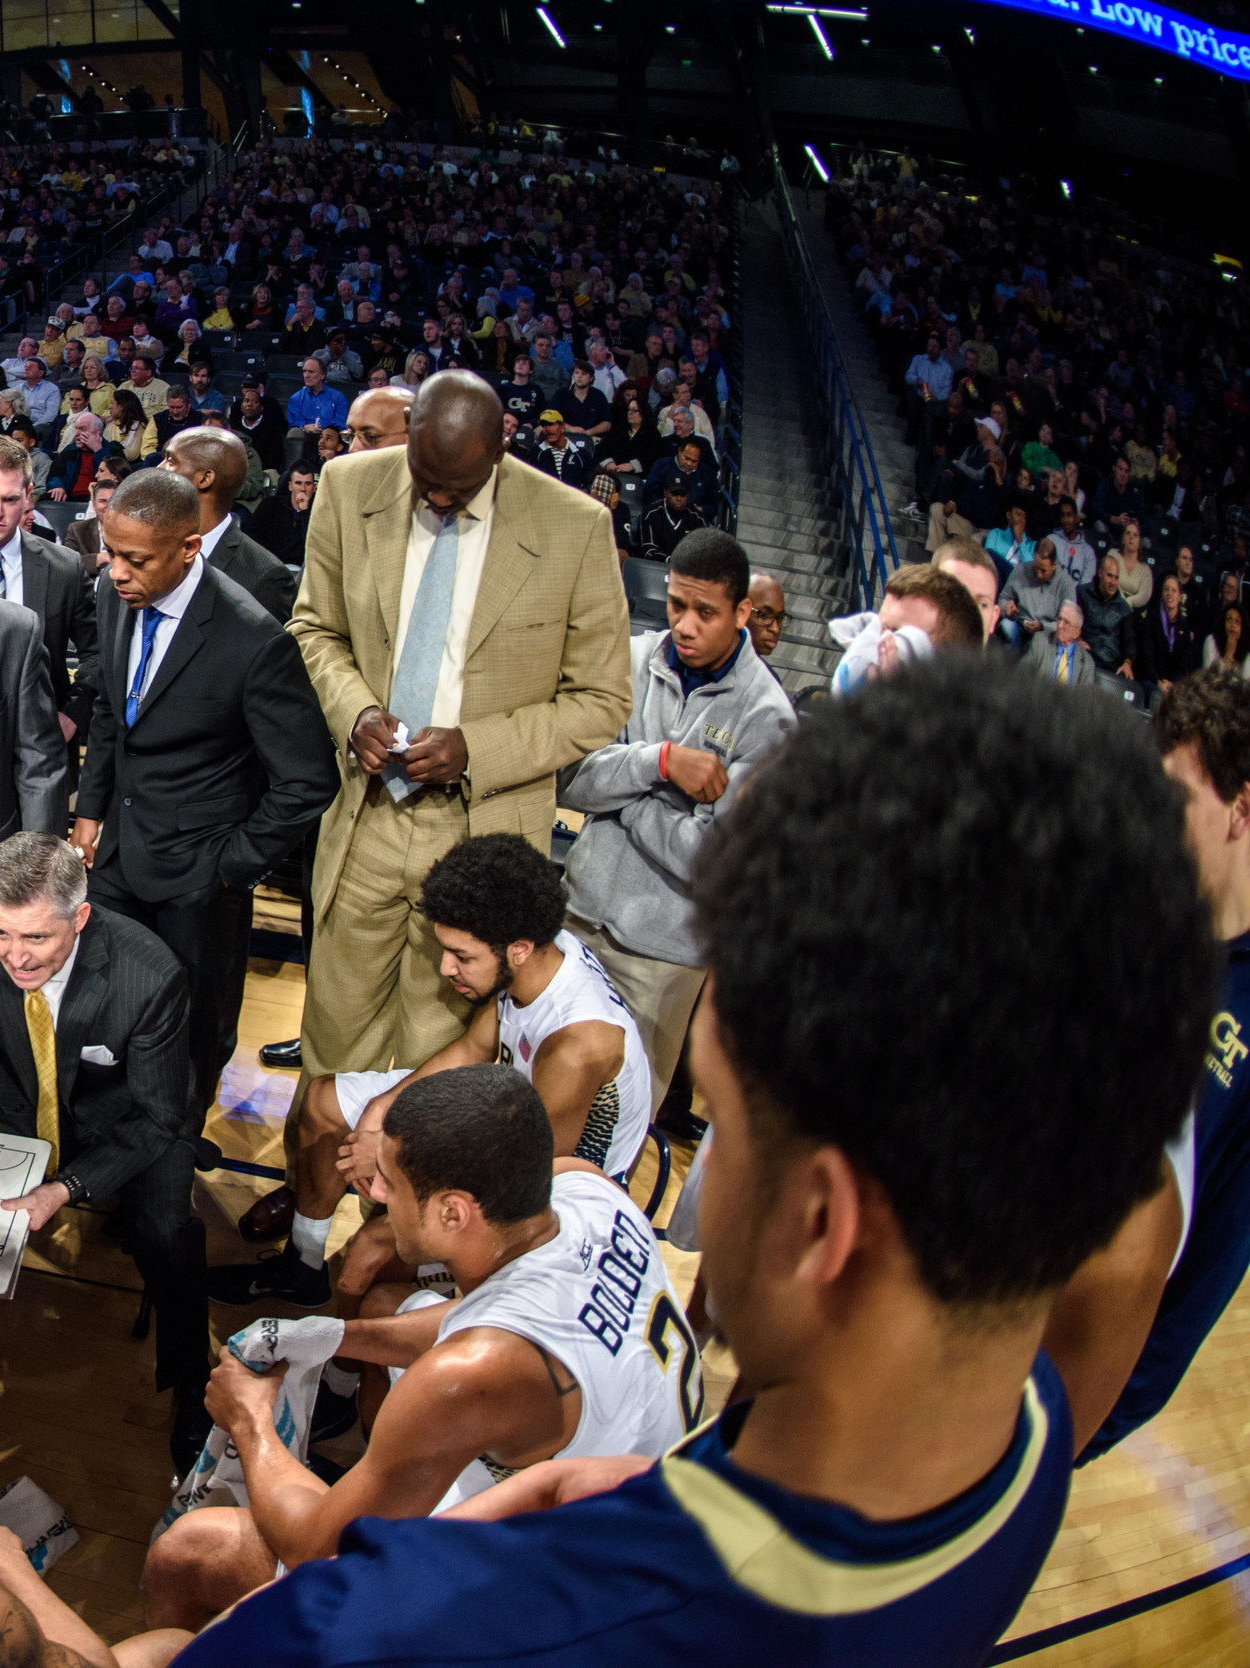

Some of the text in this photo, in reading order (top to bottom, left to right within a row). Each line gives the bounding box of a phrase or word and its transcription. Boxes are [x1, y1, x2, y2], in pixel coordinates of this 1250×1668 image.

[1170, 20, 1250, 69] price
[703, 724, 734, 752] TEC
[1210, 1011, 1249, 1069] GT
